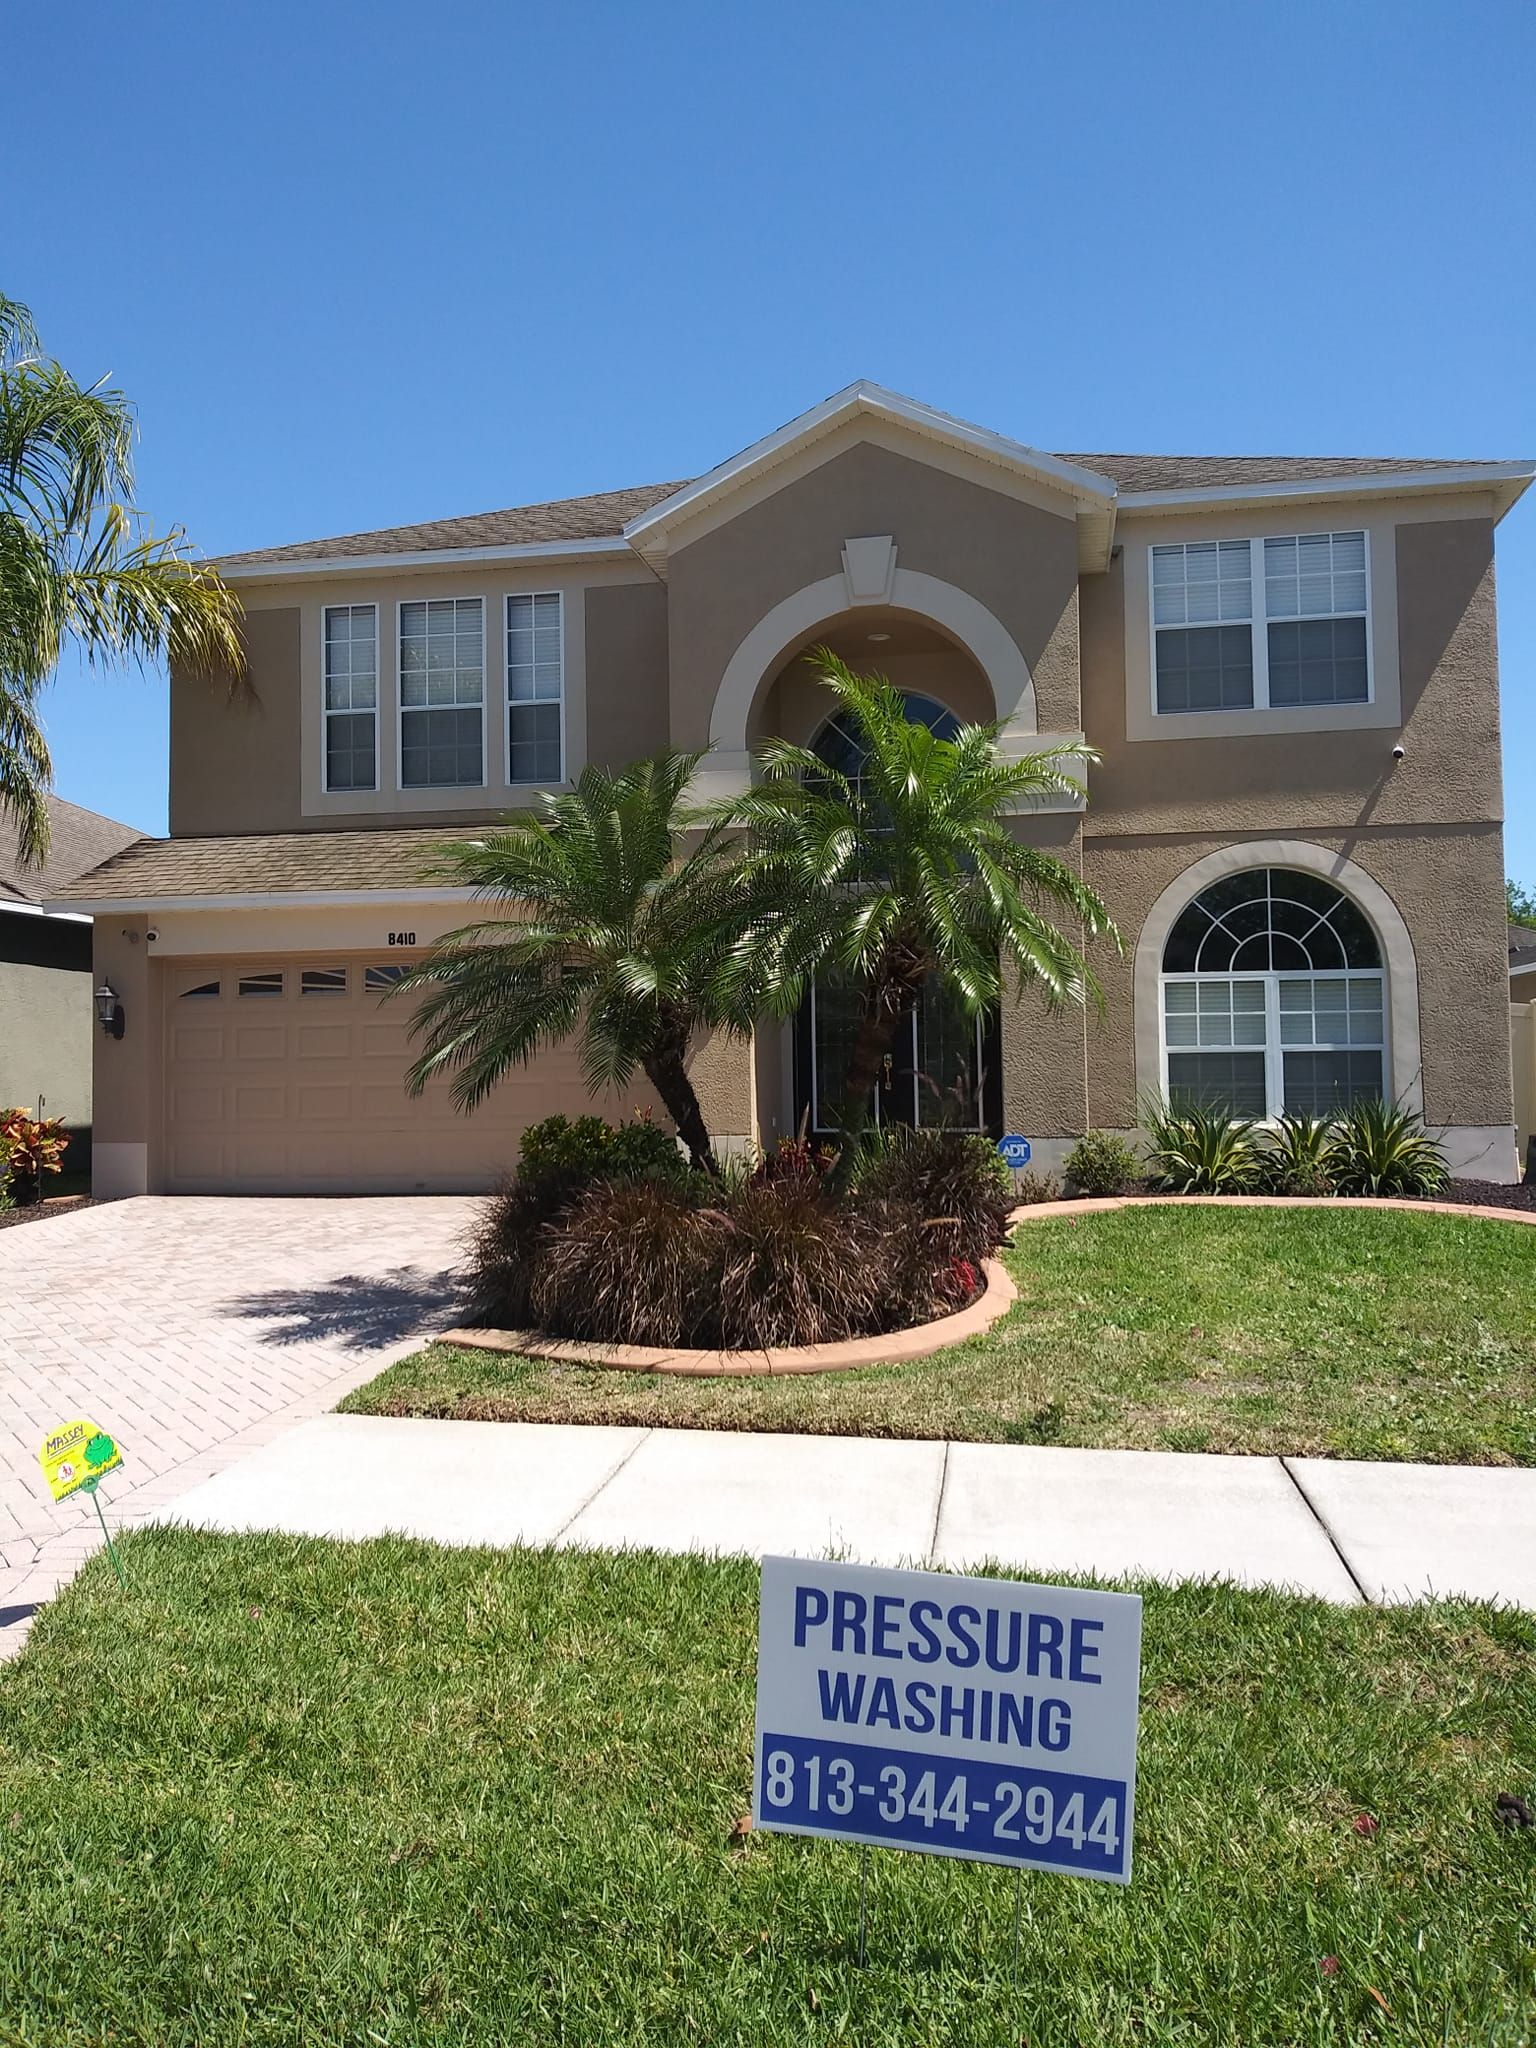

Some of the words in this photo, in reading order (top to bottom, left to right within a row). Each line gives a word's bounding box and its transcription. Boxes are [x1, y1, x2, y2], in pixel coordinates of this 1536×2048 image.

[388, 932, 416, 946] 8410
[1003, 1143, 1029, 1157] ADT
[46, 1424, 84, 1455] MASSEY
[794, 1586, 1104, 1684] PRESSURE
[817, 1669, 1072, 1752] WASHING
[766, 1750, 1120, 1856] 813-344-2944
